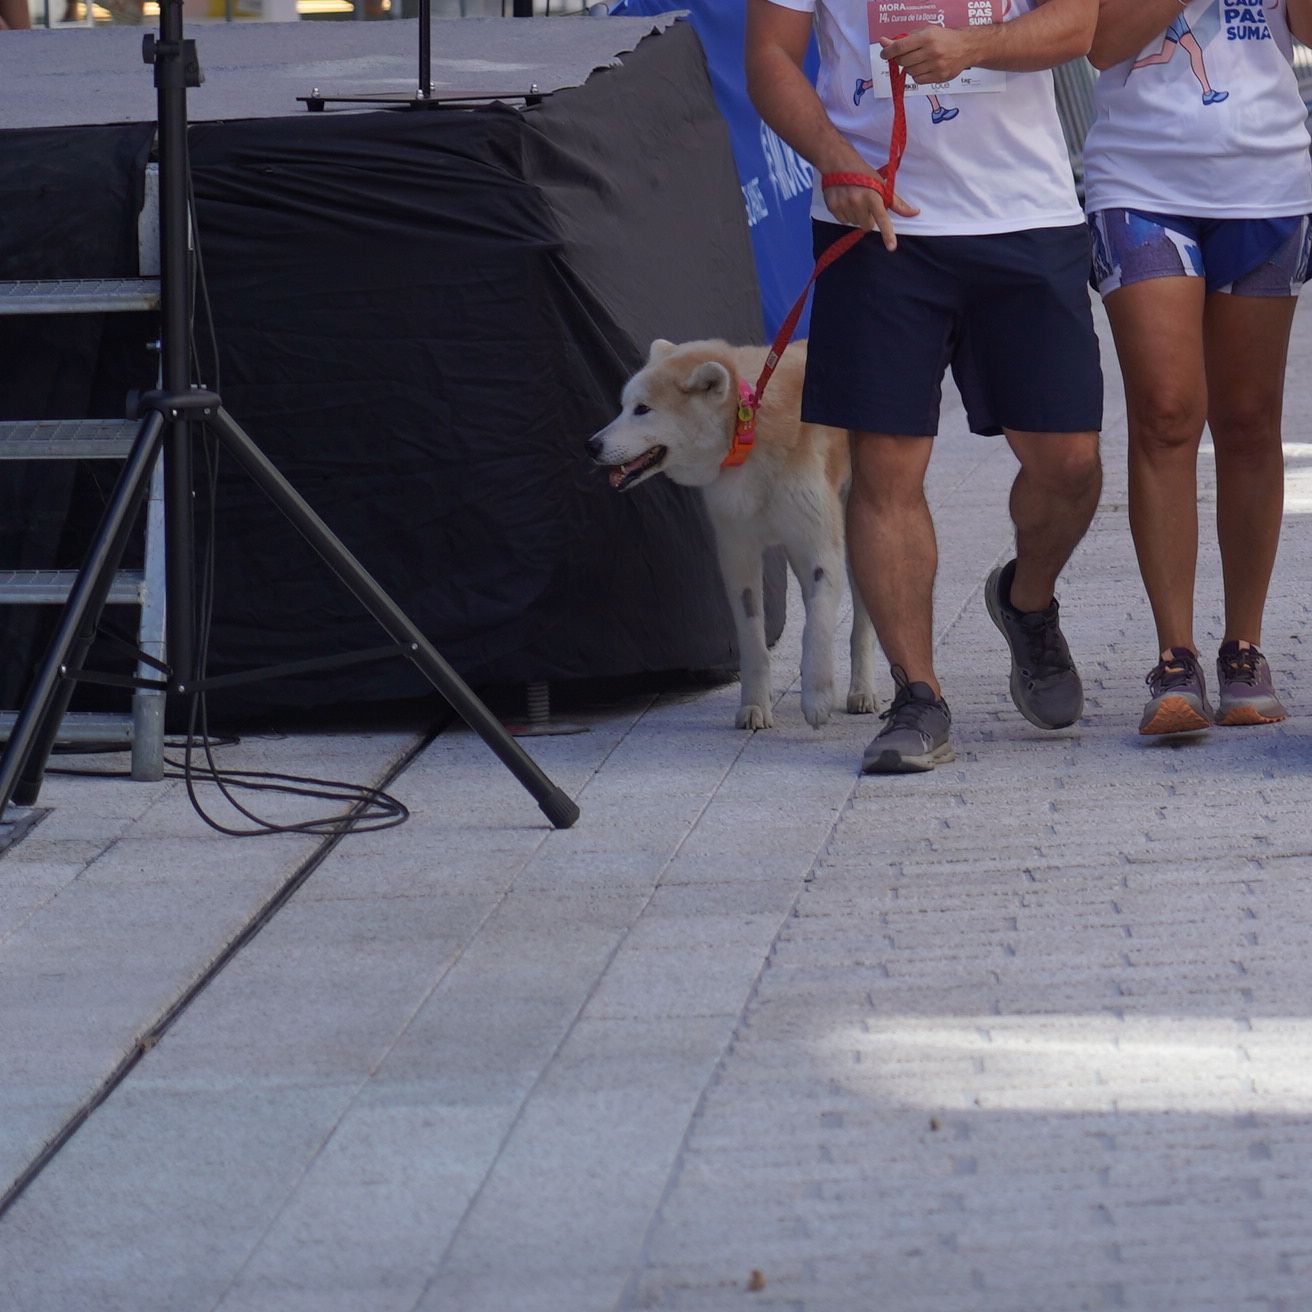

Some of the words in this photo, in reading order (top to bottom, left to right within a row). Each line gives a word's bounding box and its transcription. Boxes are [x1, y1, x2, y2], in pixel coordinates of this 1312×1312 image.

[879, 2, 906, 13] MORA
[967, 1, 992, 9] CADA
[968, 8, 993, 18] PAS
[891, 14, 907, 23] Cursa
[969, 17, 993, 26] SUMA
[1226, 25, 1272, 41] SUMA
